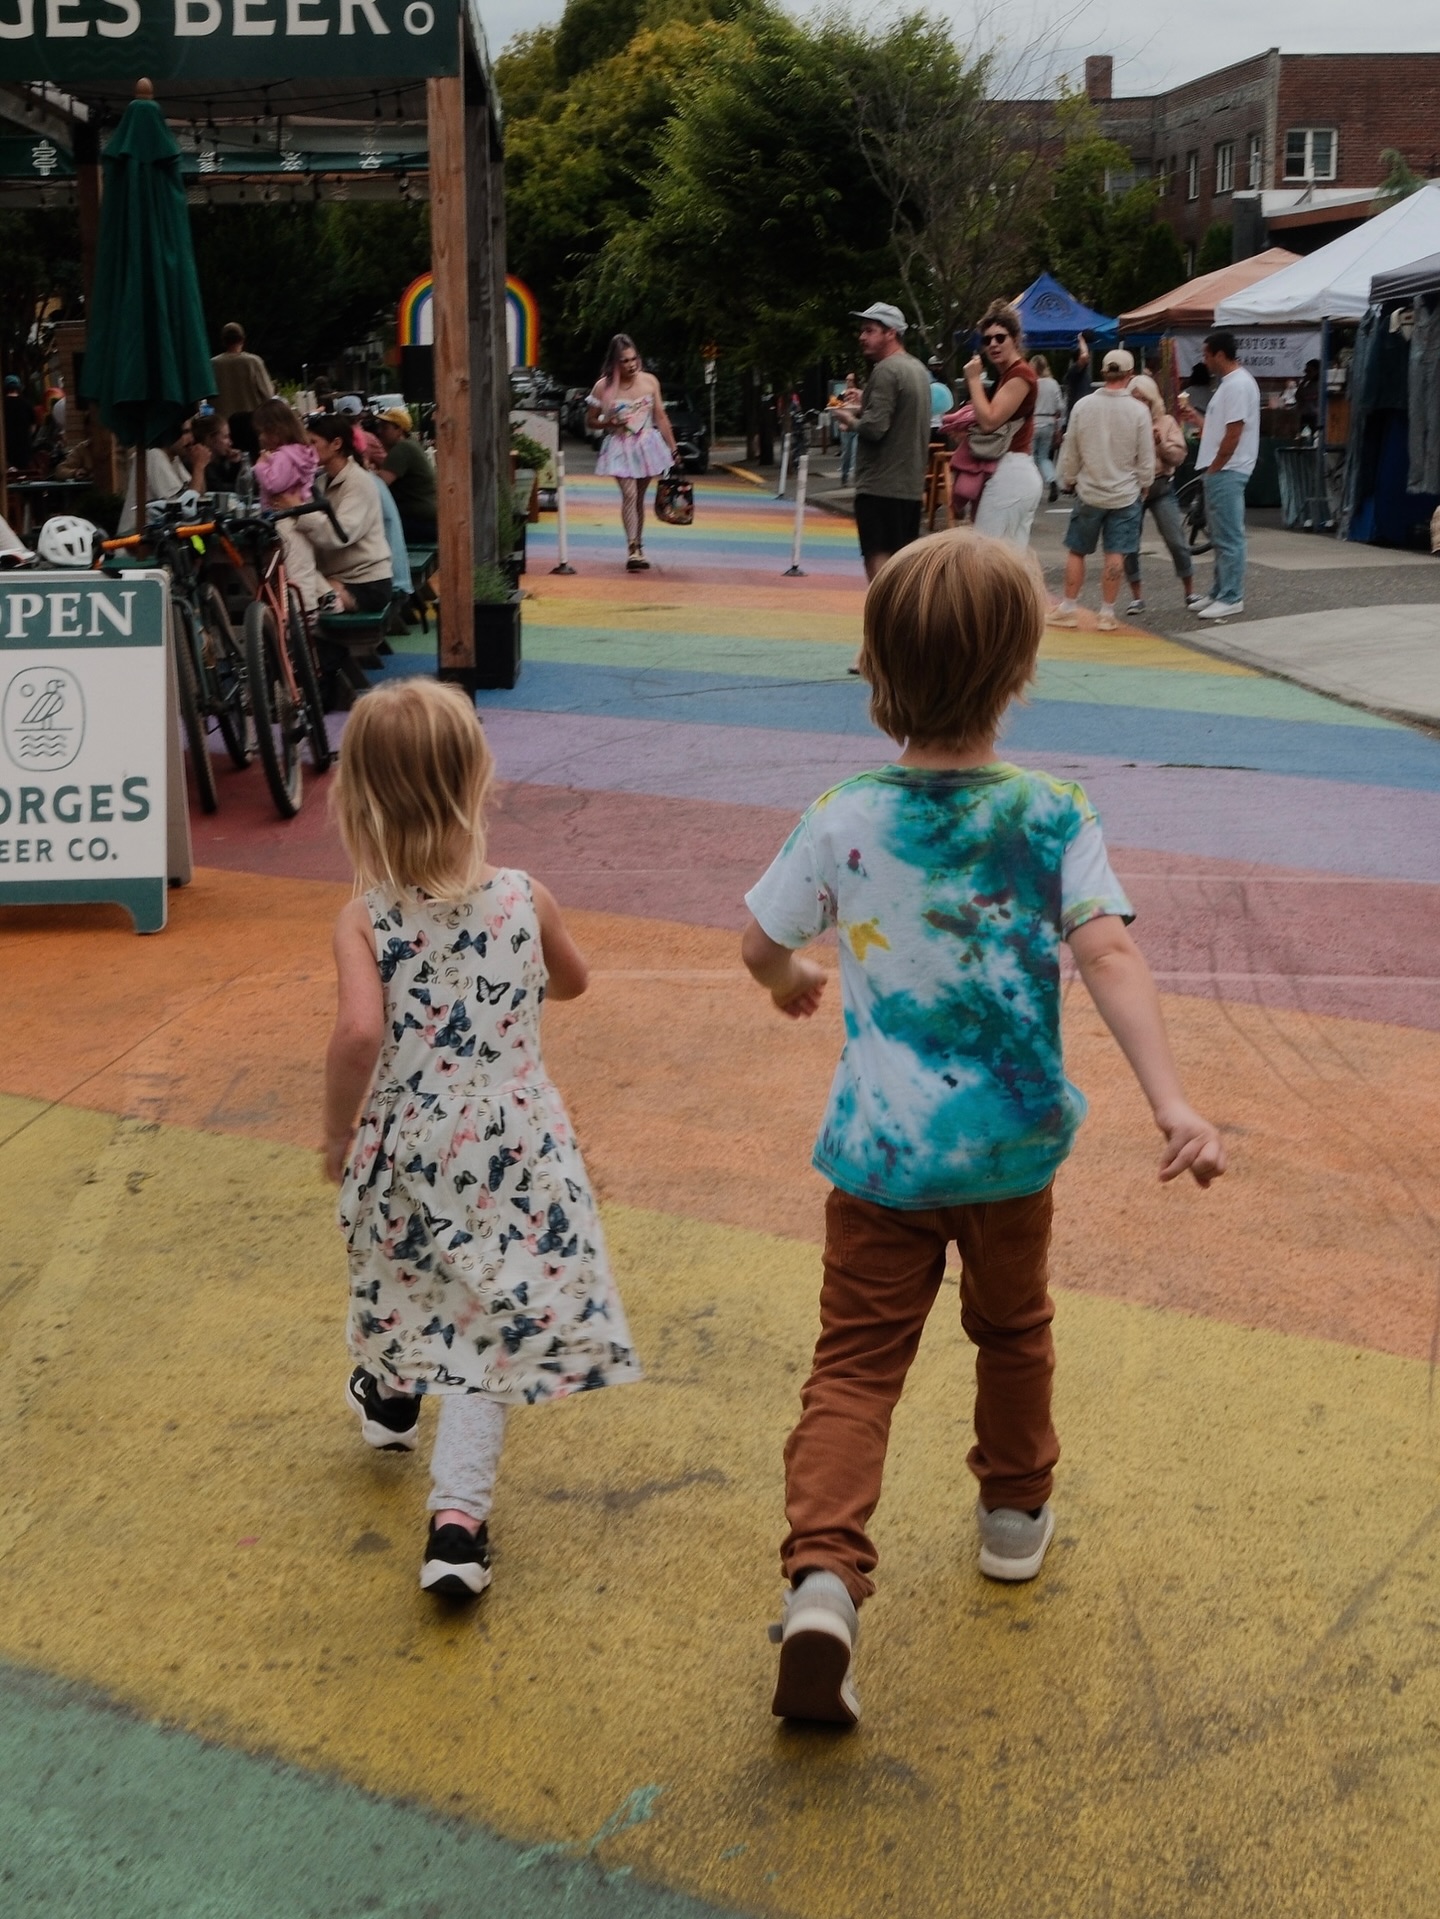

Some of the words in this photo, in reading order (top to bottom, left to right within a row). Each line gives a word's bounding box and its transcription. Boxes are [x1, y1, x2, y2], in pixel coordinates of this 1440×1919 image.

[174, 0, 391, 37] BEER
[0, 591, 138, 638] PEN
[68, 837, 118, 862] CO.
